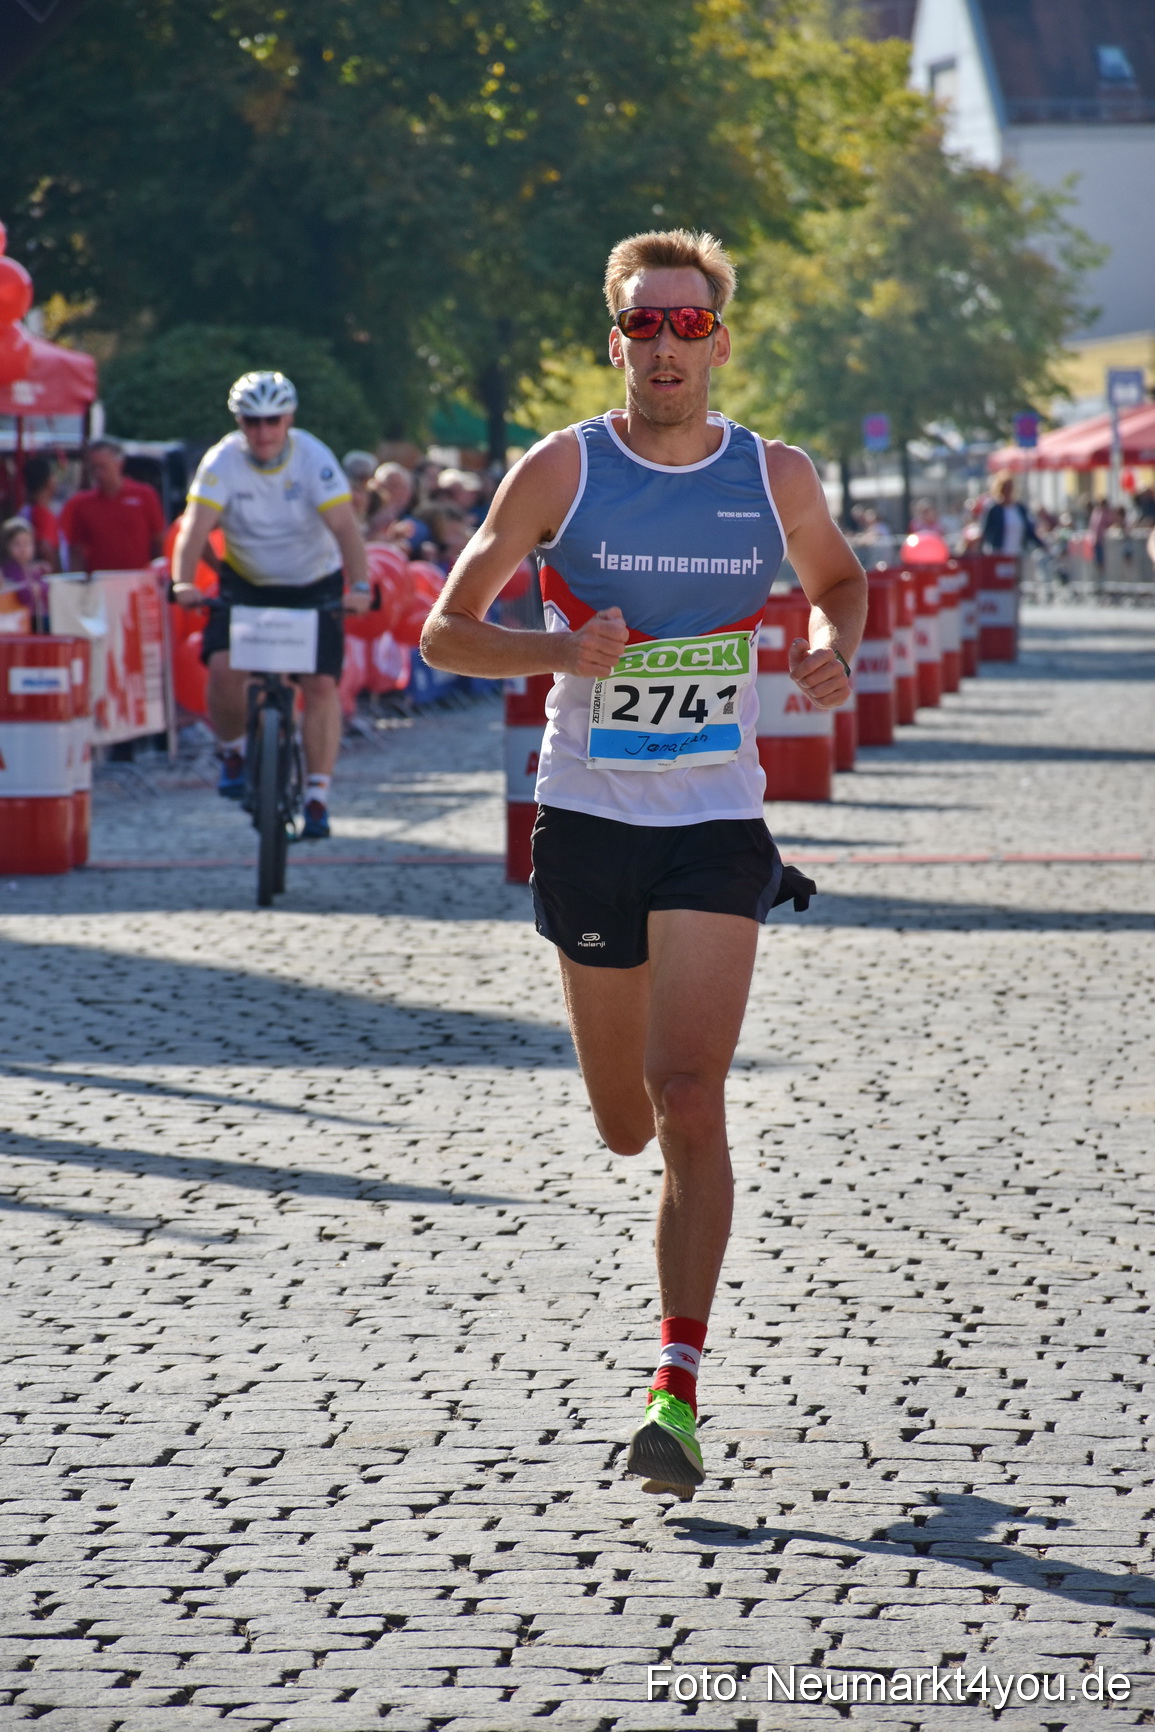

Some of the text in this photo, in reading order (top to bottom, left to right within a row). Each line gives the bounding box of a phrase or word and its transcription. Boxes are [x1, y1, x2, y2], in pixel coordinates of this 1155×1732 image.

[592, 541, 763, 575] team memmert
[611, 639, 742, 675] BOCK
